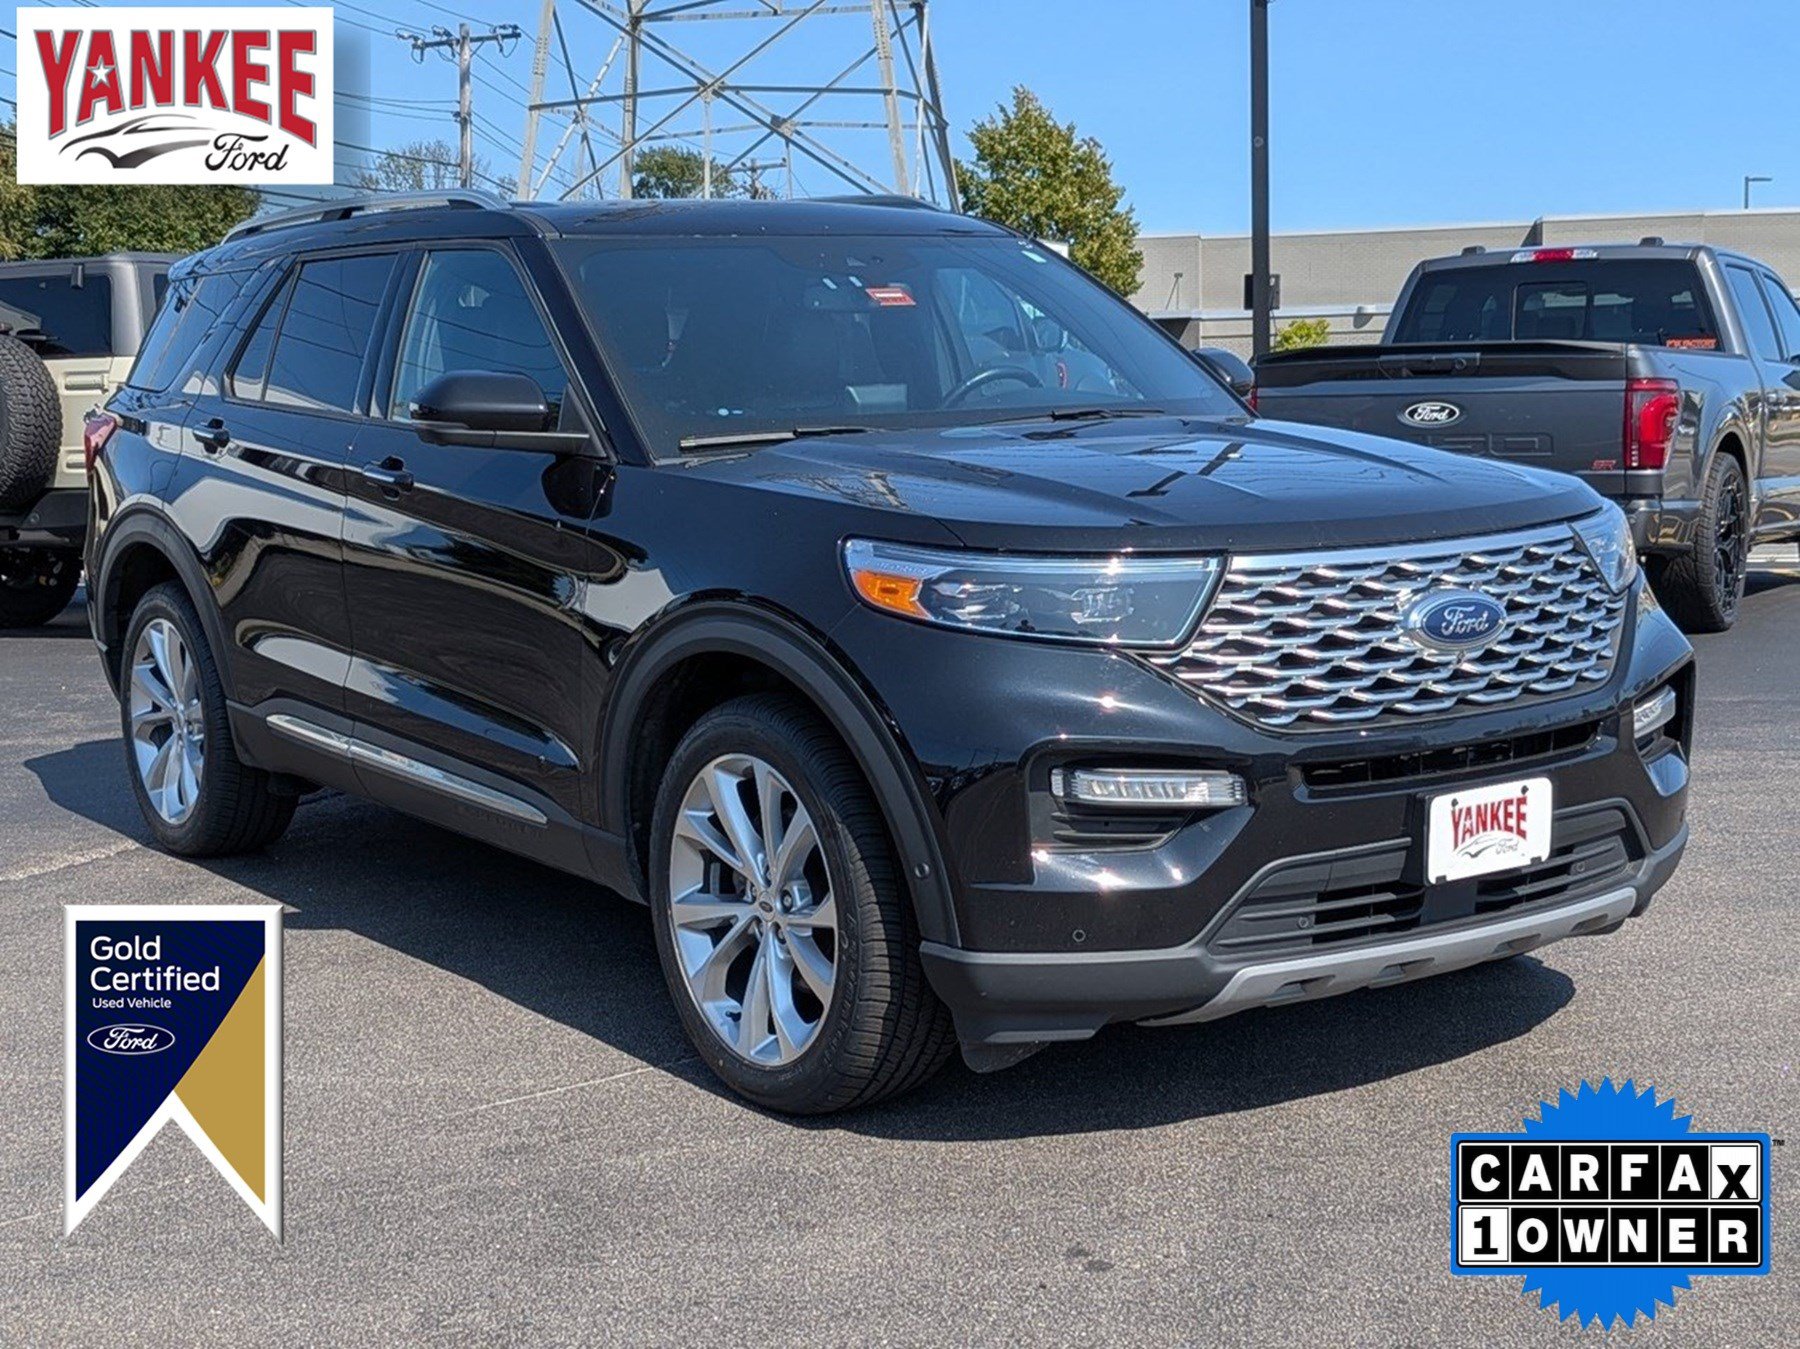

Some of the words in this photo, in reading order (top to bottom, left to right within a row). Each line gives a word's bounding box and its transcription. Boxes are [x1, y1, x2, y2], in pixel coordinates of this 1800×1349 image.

[1413, 404, 1450, 421] Ford
[1441, 605, 1490, 636] Ford
[1451, 796, 1528, 851] YANKEE
[1495, 838, 1520, 855] Ford
